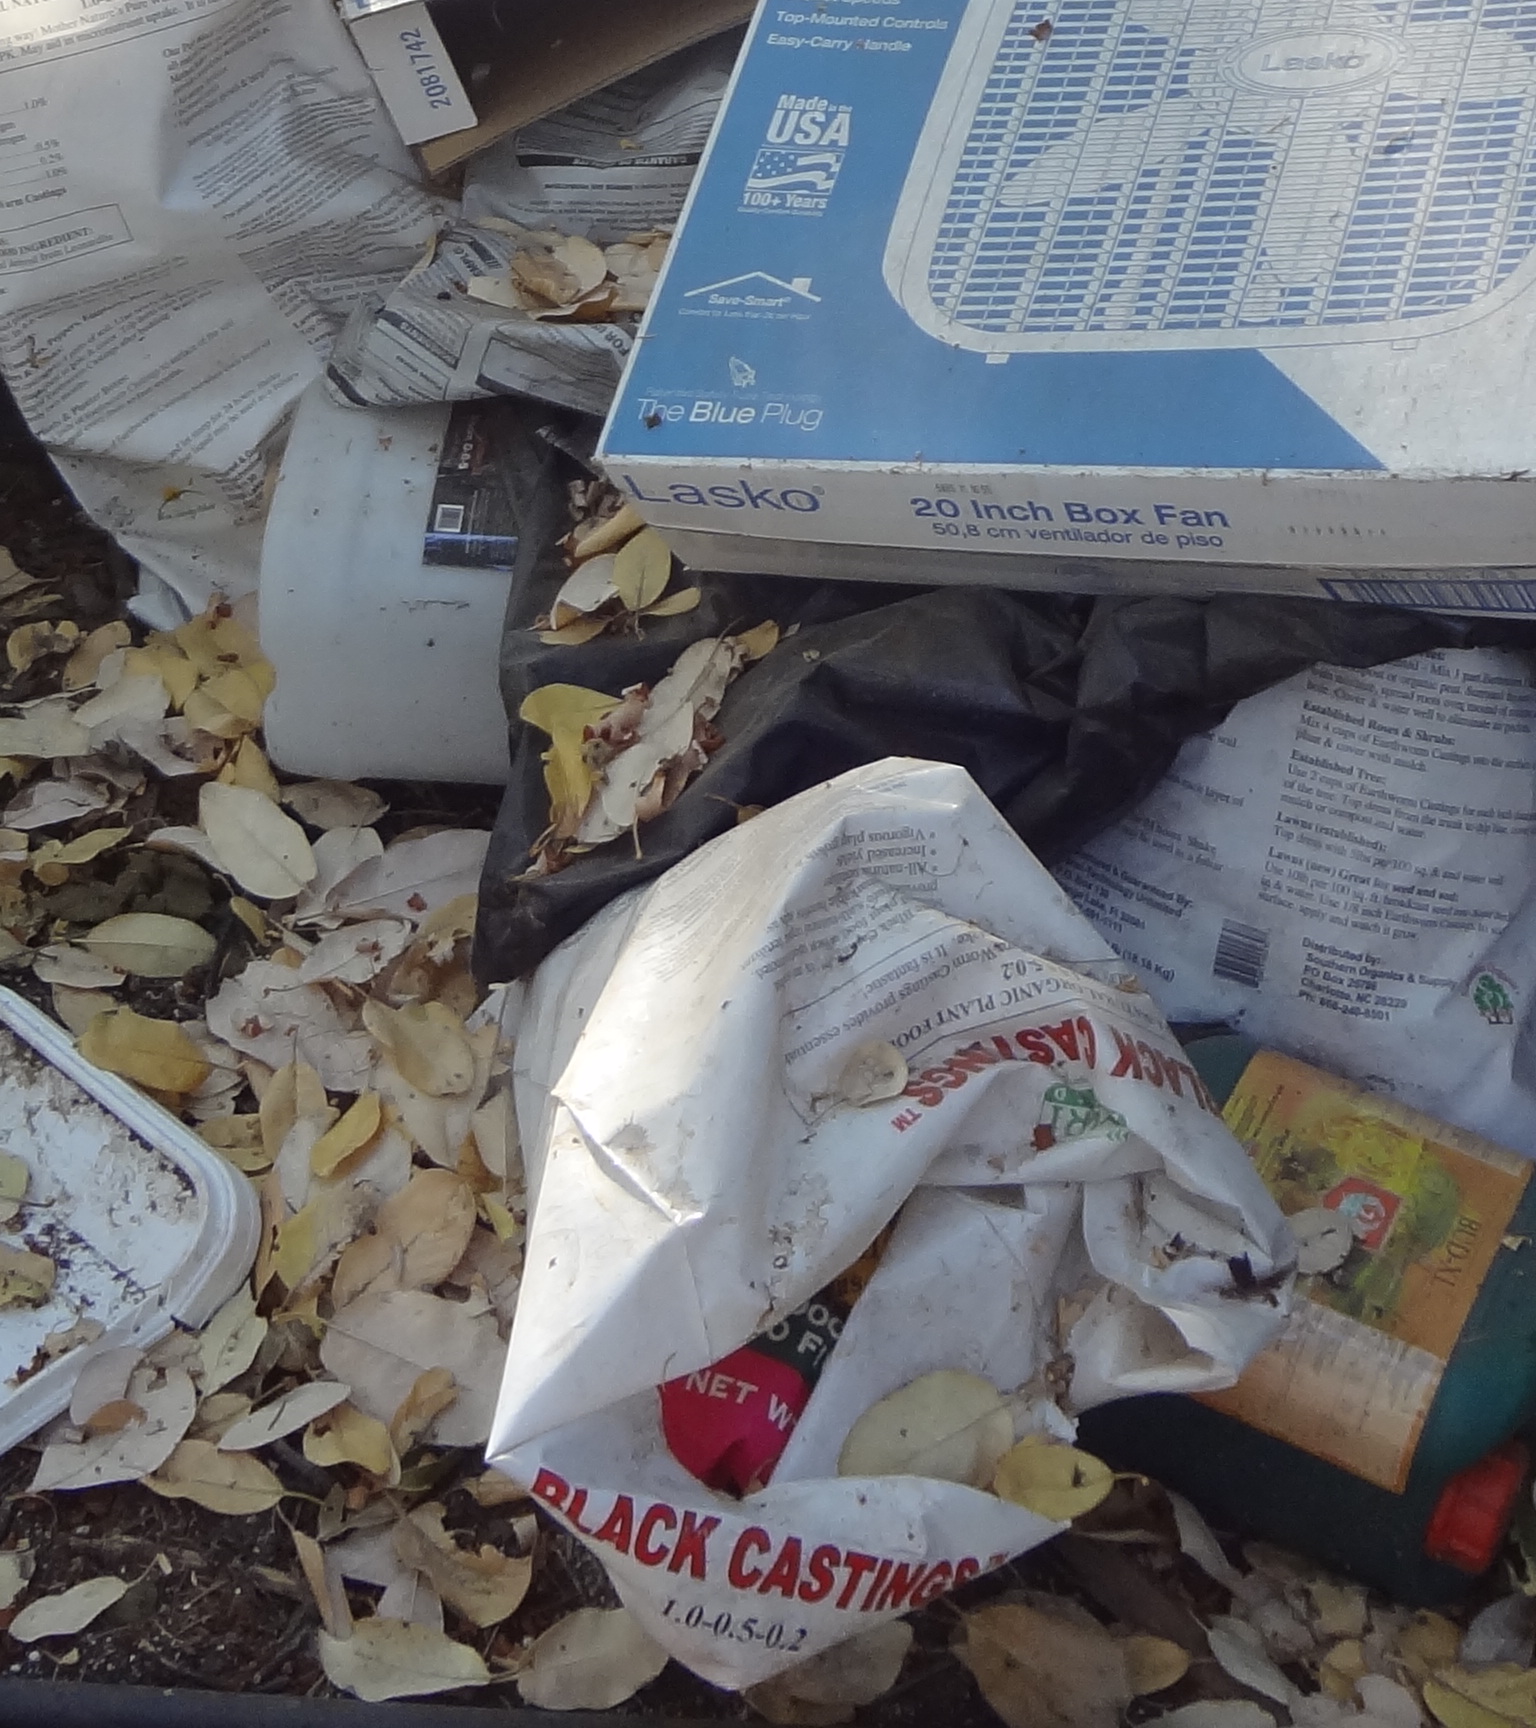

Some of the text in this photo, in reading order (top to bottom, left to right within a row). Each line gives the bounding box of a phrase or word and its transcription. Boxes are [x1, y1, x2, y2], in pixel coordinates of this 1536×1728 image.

[40, 19, 78, 36] Mother
[776, 11, 949, 30] Top-Mounted Controls
[20, 42, 44, 58] May
[766, 33, 853, 52] Easy-Carry
[399, 27, 454, 111] 2081742
[1260, 52, 1364, 72] Lasko
[777, 94, 828, 111] Made
[766, 111, 851, 148] USA
[24, 187, 68, 206] Castings
[741, 191, 828, 210] 100+ Years
[637, 398, 824, 432] The Blue Plug
[622, 474, 821, 513] Lasko
[909, 496, 1230, 530] 20 Inch Box Fan
[932, 520, 1225, 552] 50,8 cm ventilador de piso
[1299, 714, 1321, 729] Mix
[1331, 723, 1356, 741] cups
[1302, 699, 1366, 727] Established
[1367, 719, 1400, 737] Roses
[1290, 748, 1355, 777] Established
[1287, 762, 1308, 780] Use
[1318, 773, 1344, 791] cups
[1341, 793, 1363, 811] Top
[868, 826, 926, 843] Vigorous
[1272, 825, 1296, 842] Top
[1275, 810, 1389, 854] Lawns (established):
[867, 844, 928, 860] Increased
[1264, 860, 1285, 876] Use
[1267, 846, 1304, 869] Lawns
[1305, 857, 1337, 879] (new)
[1337, 866, 1372, 887] Great
[1318, 892, 1340, 909] Use
[922, 951, 934, 964] is
[935, 944, 948, 957] It
[1301, 936, 1365, 964] Distributed
[899, 964, 952, 999] Castings
[1303, 964, 1346, 985] PO Box
[1305, 952, 1405, 984] Southern Organics
[849, 986, 899, 1028] provides
[943, 994, 996, 1027] PLANT
[1355, 992, 1373, 1006] NC
[684, 1369, 760, 1406] NET
[661, 1597, 810, 1654] 1.0-0.5-0.2
